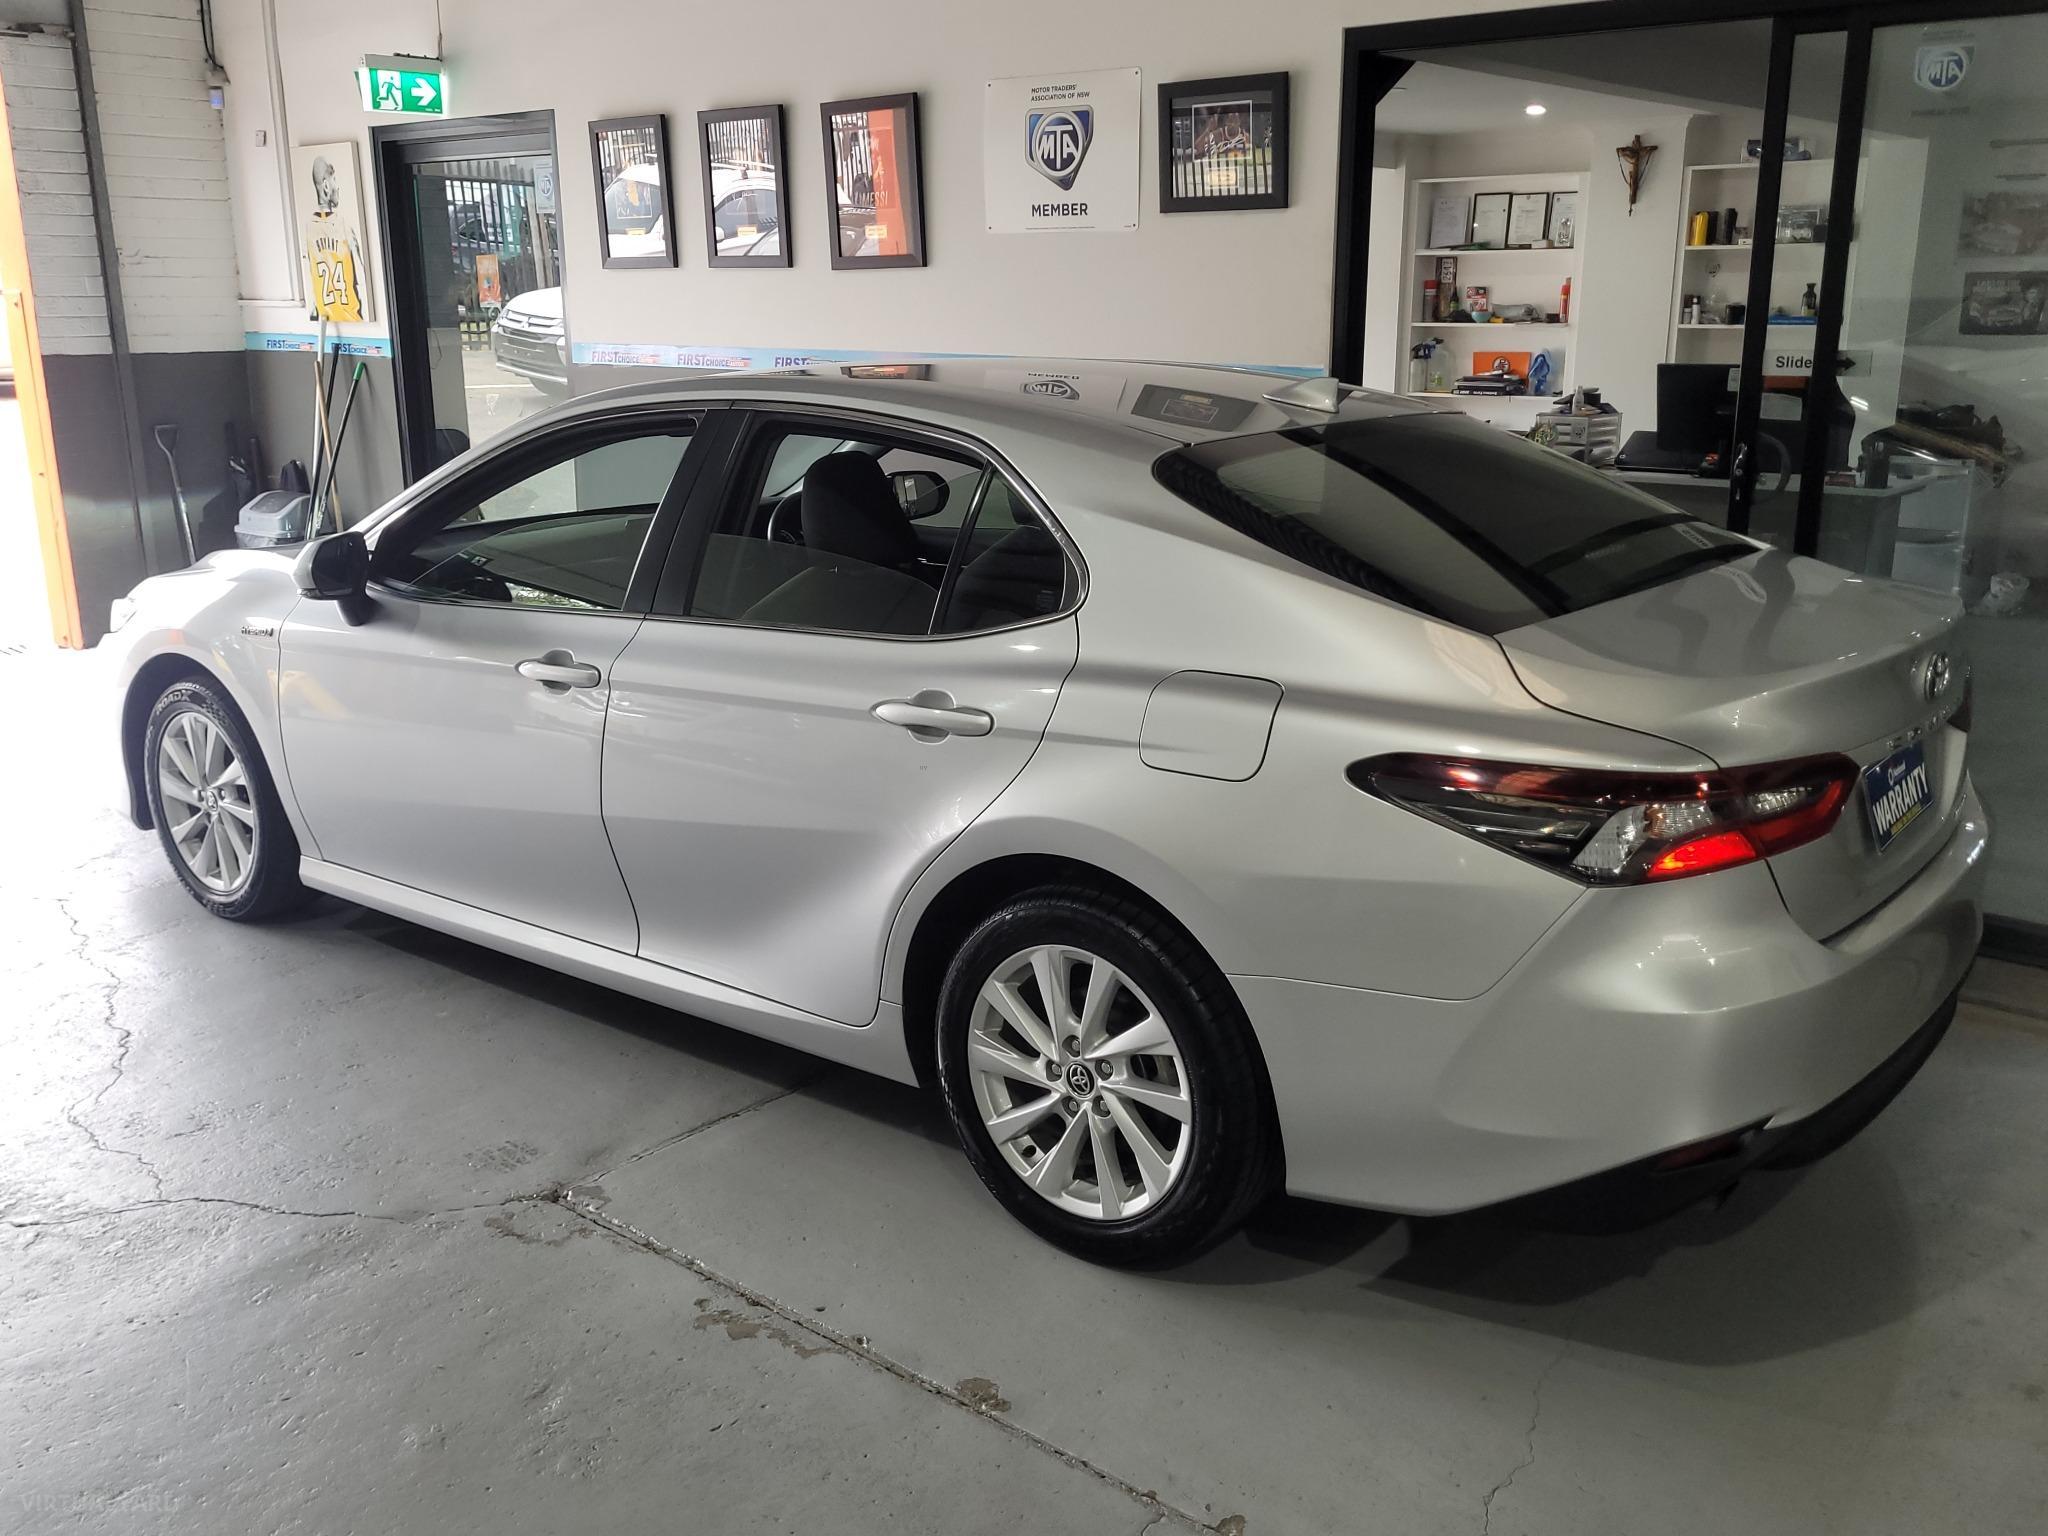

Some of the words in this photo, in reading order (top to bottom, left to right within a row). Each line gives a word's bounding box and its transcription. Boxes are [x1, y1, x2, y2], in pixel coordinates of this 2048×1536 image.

[1031, 86, 1050, 94] MOTOR
[1031, 93, 1067, 102] ASSOCIATION
[1077, 91, 1090, 99] NSW
[1040, 124, 1078, 170] MTA
[1032, 203, 1088, 217] MEMBER
[316, 261, 349, 306] 24
[1775, 355, 1813, 369] Slide
[1872, 762, 1928, 835] WARRANTY
